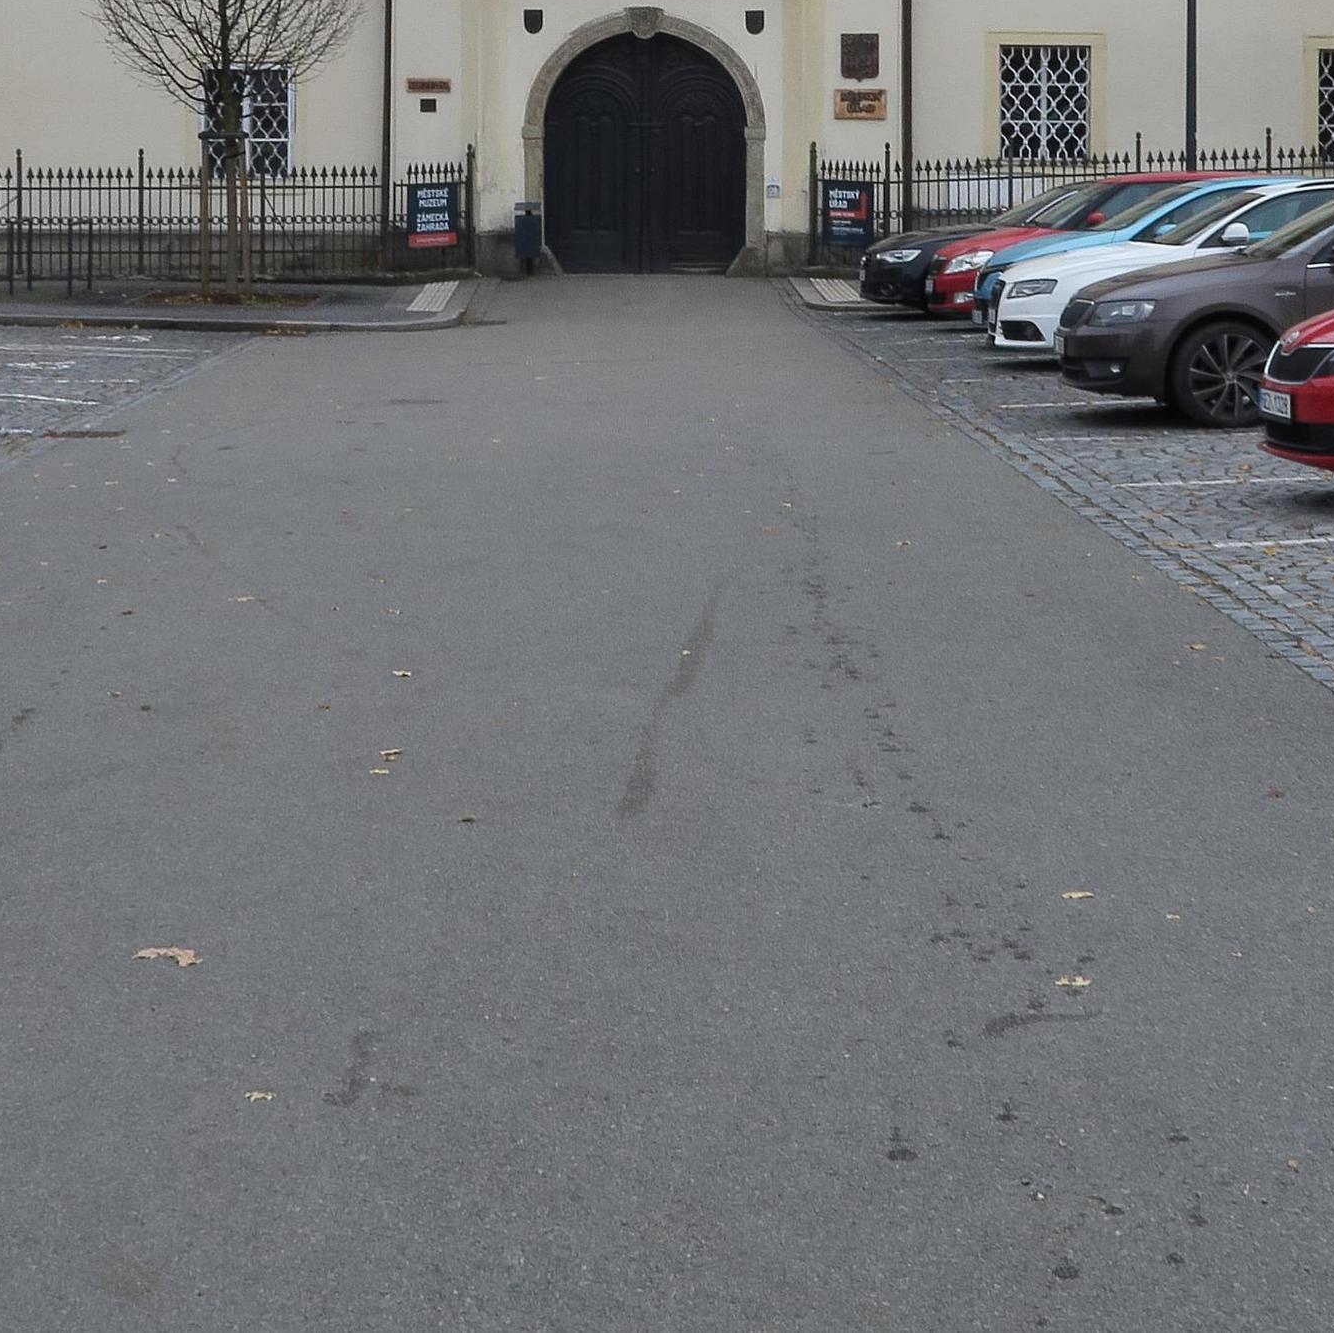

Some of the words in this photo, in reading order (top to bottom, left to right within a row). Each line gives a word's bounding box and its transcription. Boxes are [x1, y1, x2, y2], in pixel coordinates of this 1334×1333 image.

[419, 198, 447, 208] MUZEUM
[417, 211, 449, 222] ZÁMECKÁ
[417, 222, 449, 232] ZAHRADA
